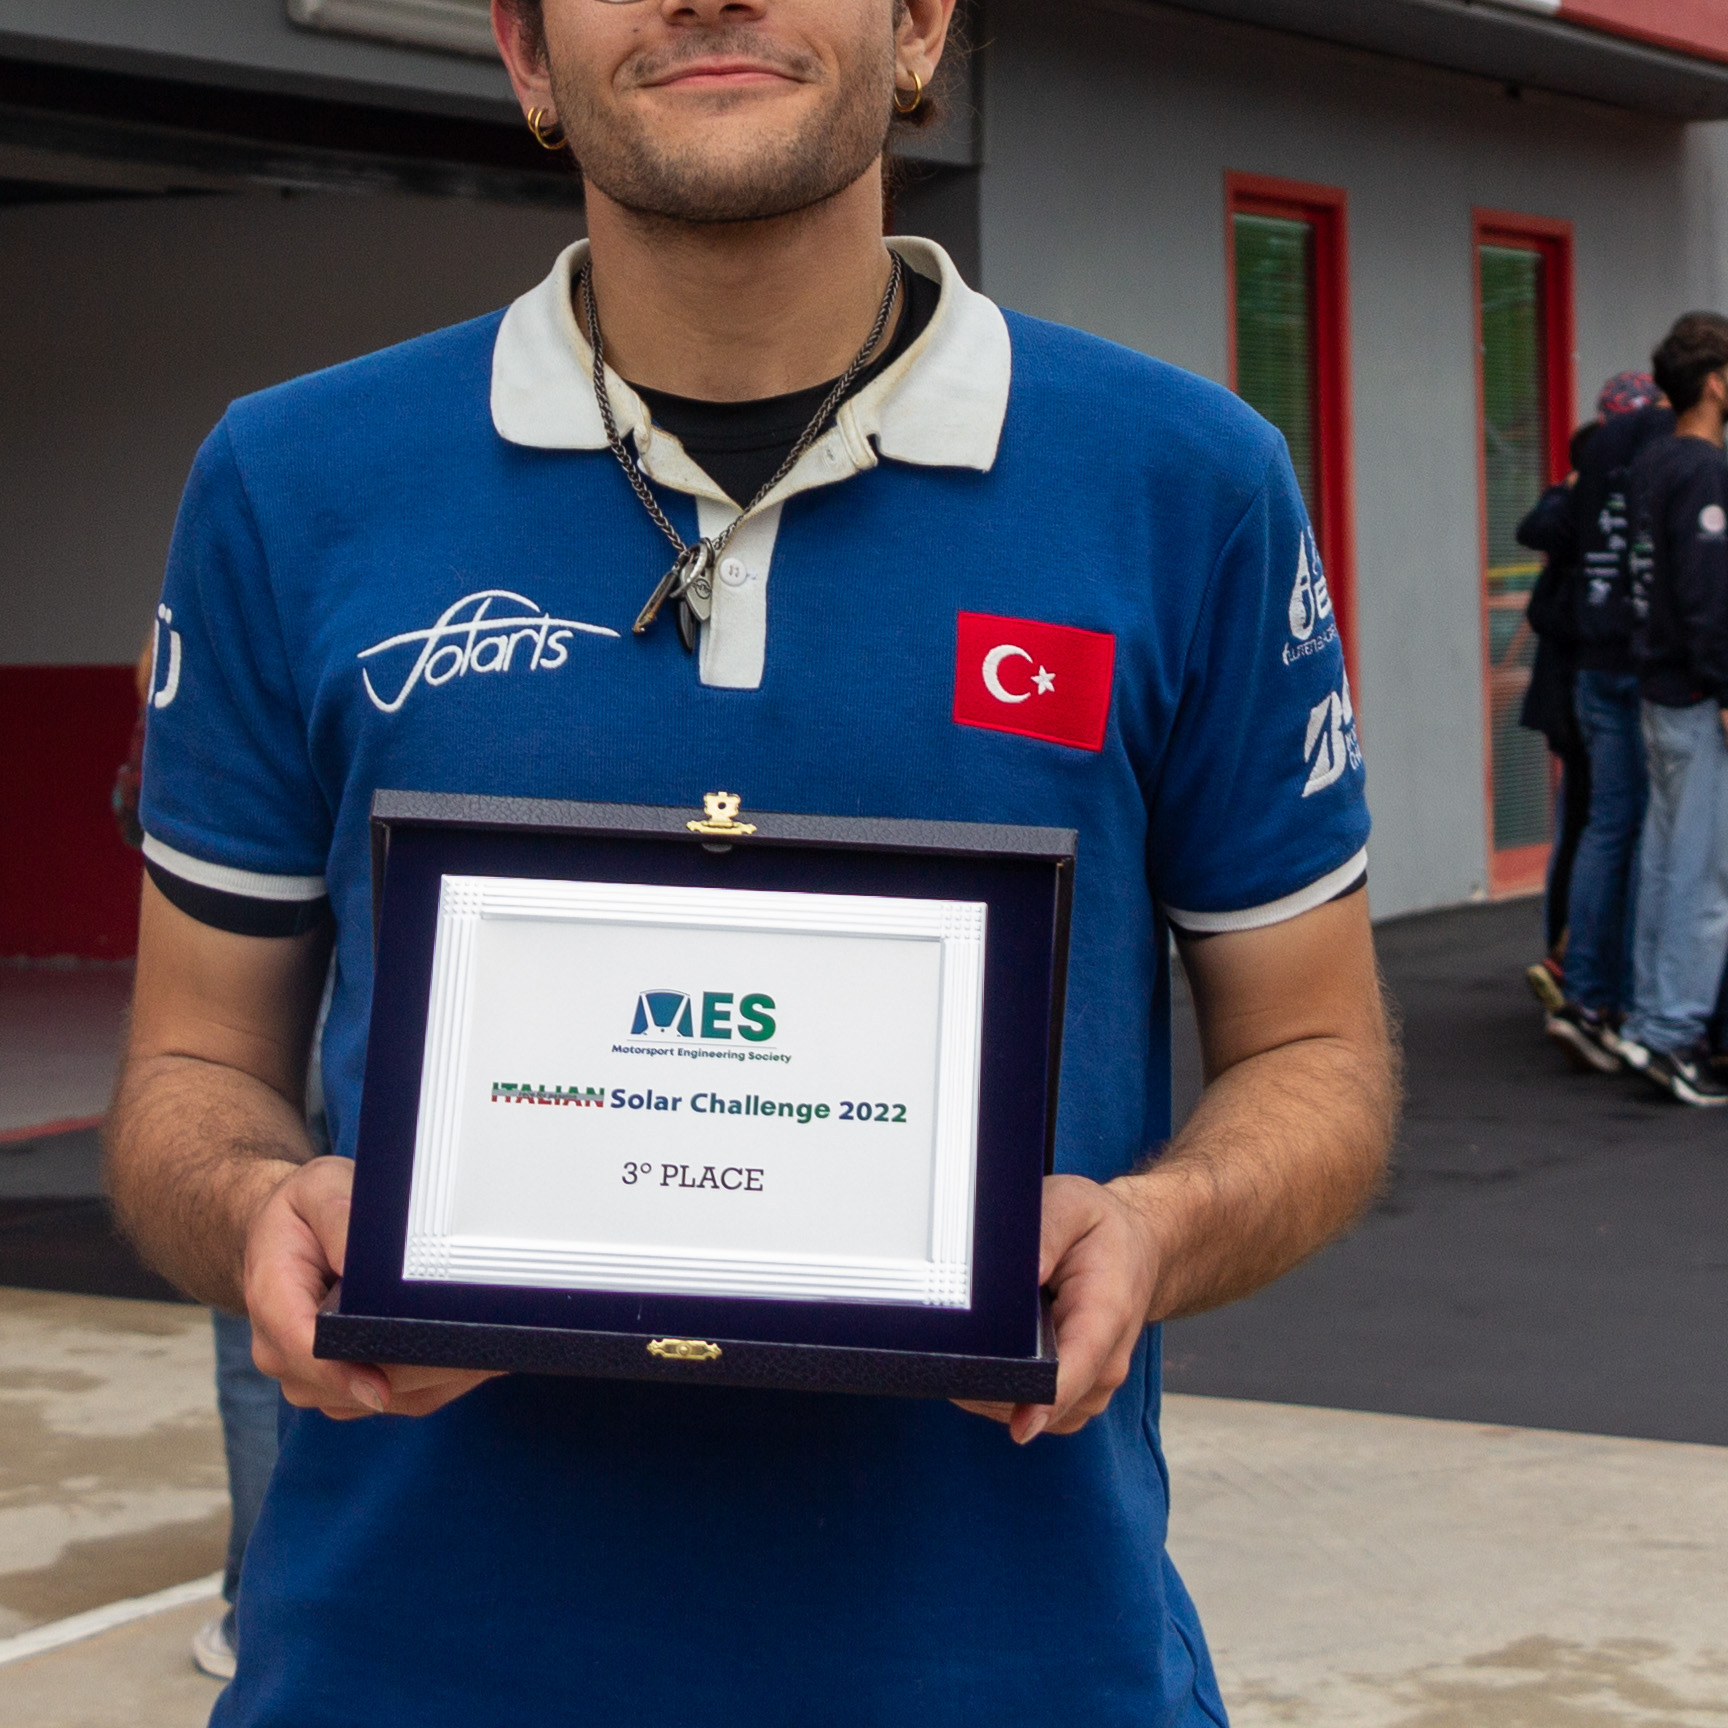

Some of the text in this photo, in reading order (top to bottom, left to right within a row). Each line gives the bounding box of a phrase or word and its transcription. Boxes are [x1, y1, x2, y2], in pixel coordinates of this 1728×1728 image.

[630, 988, 777, 1043] MES
[612, 1044, 792, 1064] Motorsport Engineering Society
[491, 1082, 908, 1125] ITALIAN Solar Challenge 2022
[659, 1164, 765, 1192] PLACE
